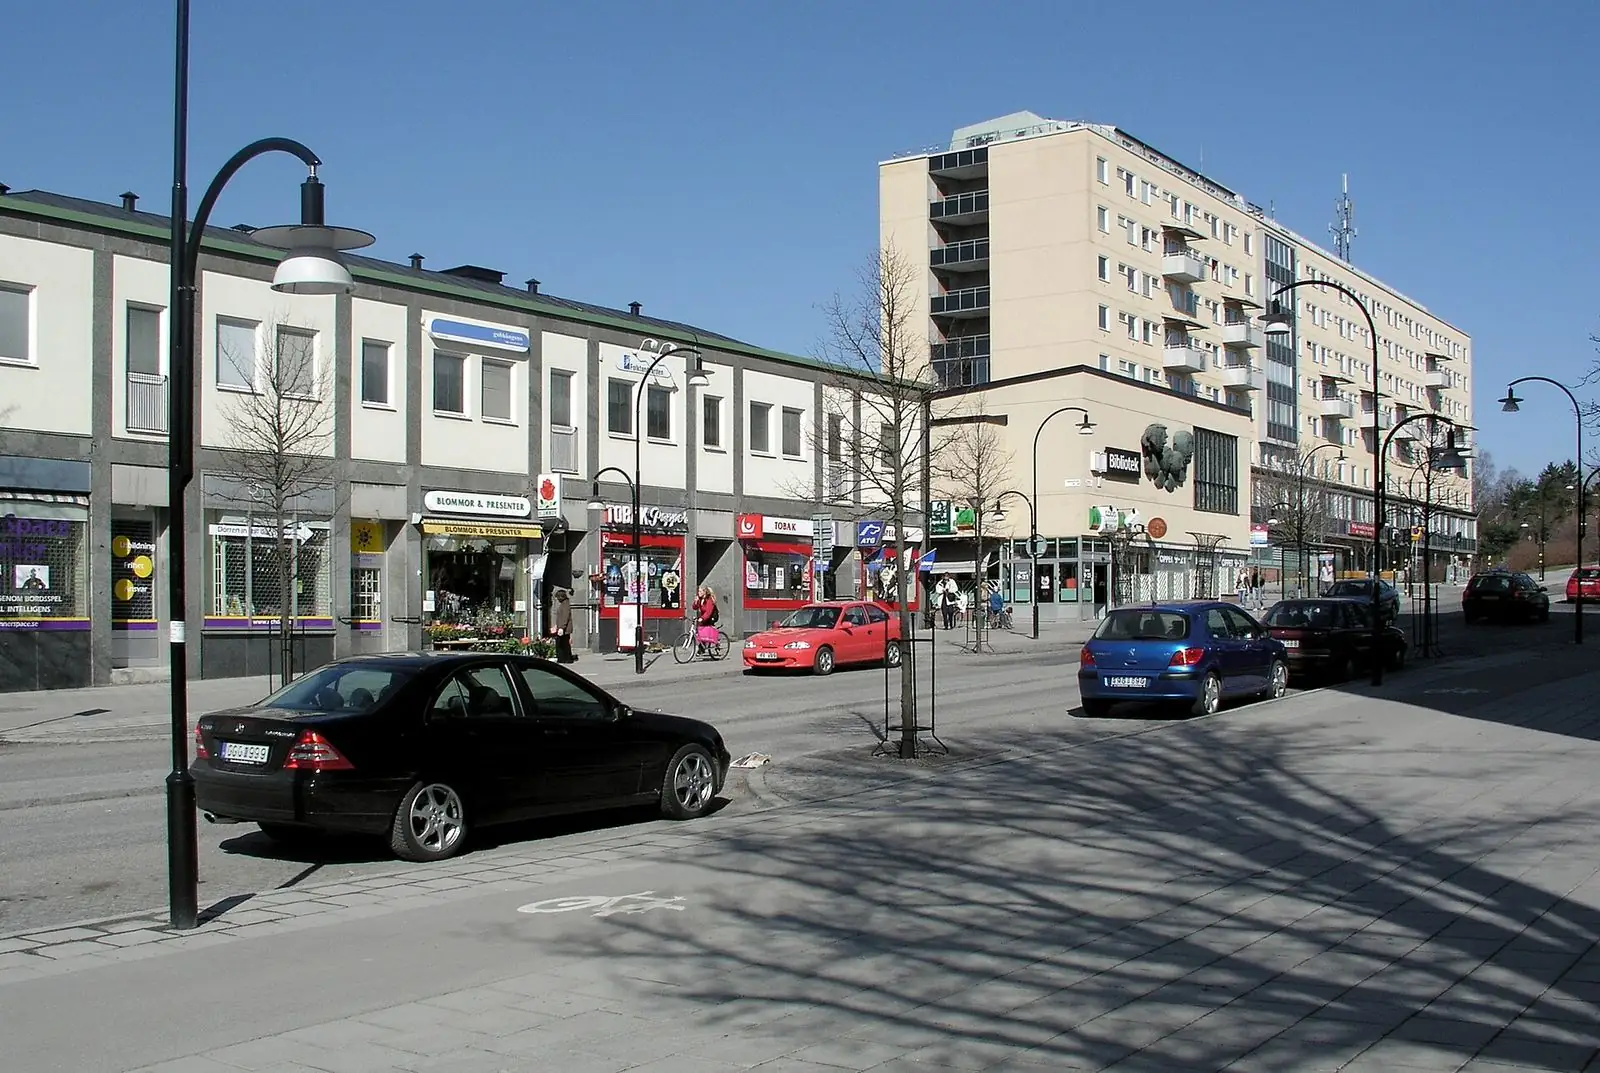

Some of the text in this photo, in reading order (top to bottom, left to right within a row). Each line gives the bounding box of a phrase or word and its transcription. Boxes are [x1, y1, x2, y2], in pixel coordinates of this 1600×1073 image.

[1109, 453, 1139, 472] Bibliotek
[437, 497, 524, 511] BLOMMOR & PRESENTER
[606, 504, 648, 526] TOBK
[445, 526, 478, 534] BLOMMOR
[774, 521, 797, 531] TOBAK
[7, 605, 51, 613] INTELLIGENS
